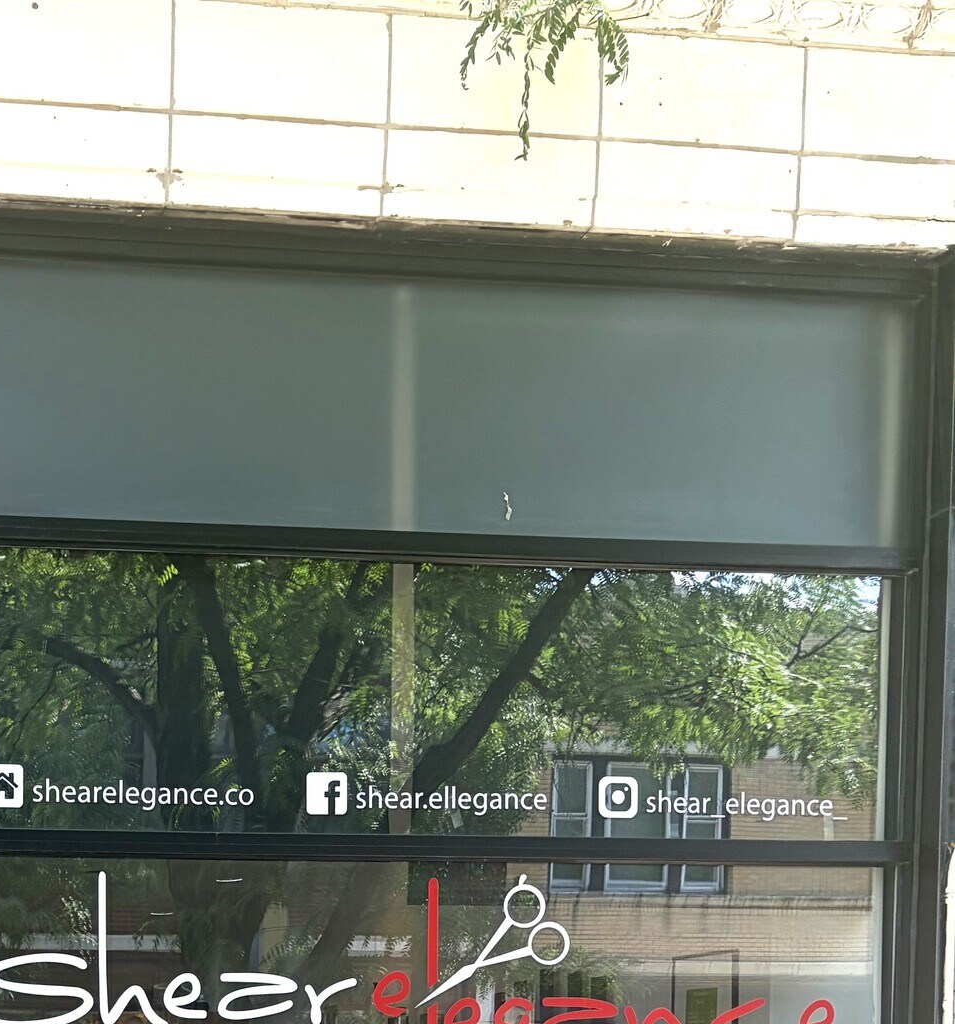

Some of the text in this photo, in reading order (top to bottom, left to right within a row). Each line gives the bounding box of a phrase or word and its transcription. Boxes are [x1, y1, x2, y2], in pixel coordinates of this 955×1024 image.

[32, 778, 255, 811] shearelegance.co
[355, 785, 548, 816] shear.ellegance
[645, 790, 849, 822] shear_elegance_
